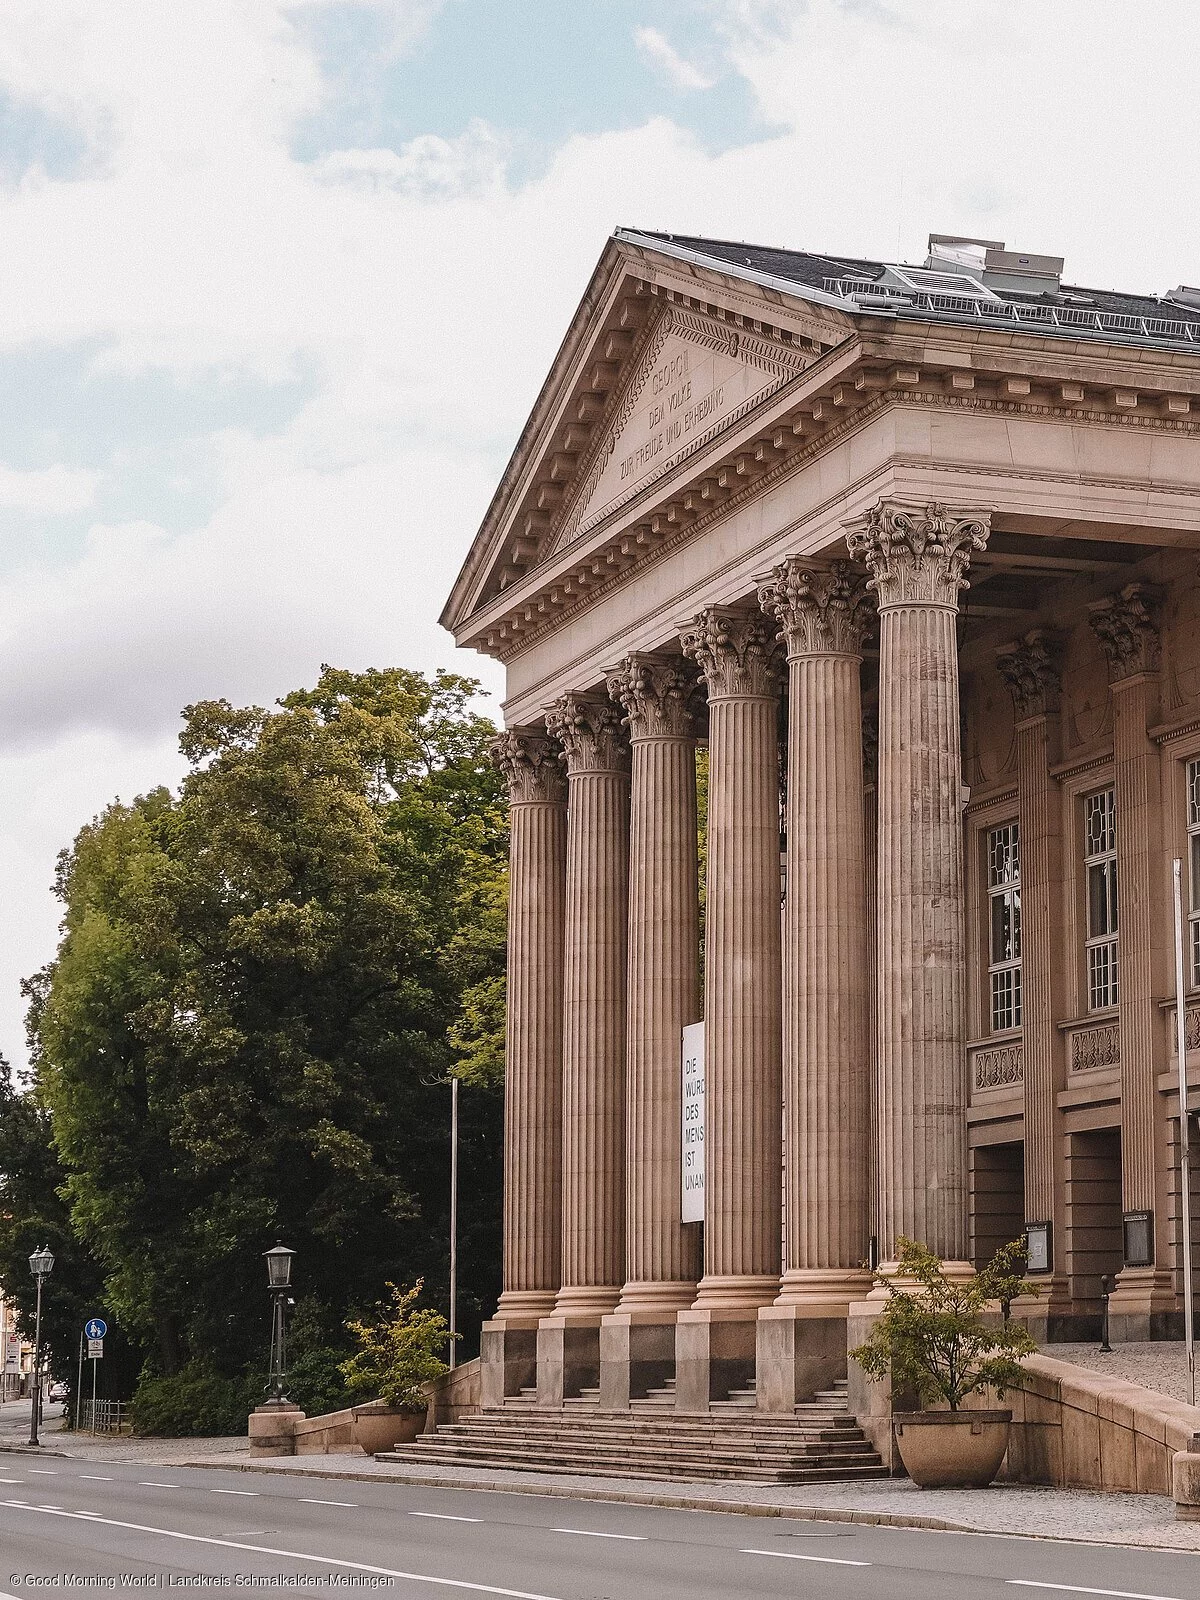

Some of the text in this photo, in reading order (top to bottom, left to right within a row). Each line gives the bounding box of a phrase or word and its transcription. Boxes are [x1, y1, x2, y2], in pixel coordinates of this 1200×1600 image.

[652, 349, 689, 395] GEORG II
[649, 381, 692, 430] DEM VOLKE
[620, 386, 724, 481] ZUR FREUDE UND ERHEBUNG
[686, 1058, 696, 1074] DIE
[685, 1104, 699, 1121] DES
[685, 1126, 704, 1144] MENS
[685, 1151, 695, 1167] IST
[685, 1173, 704, 1190] UNAN
